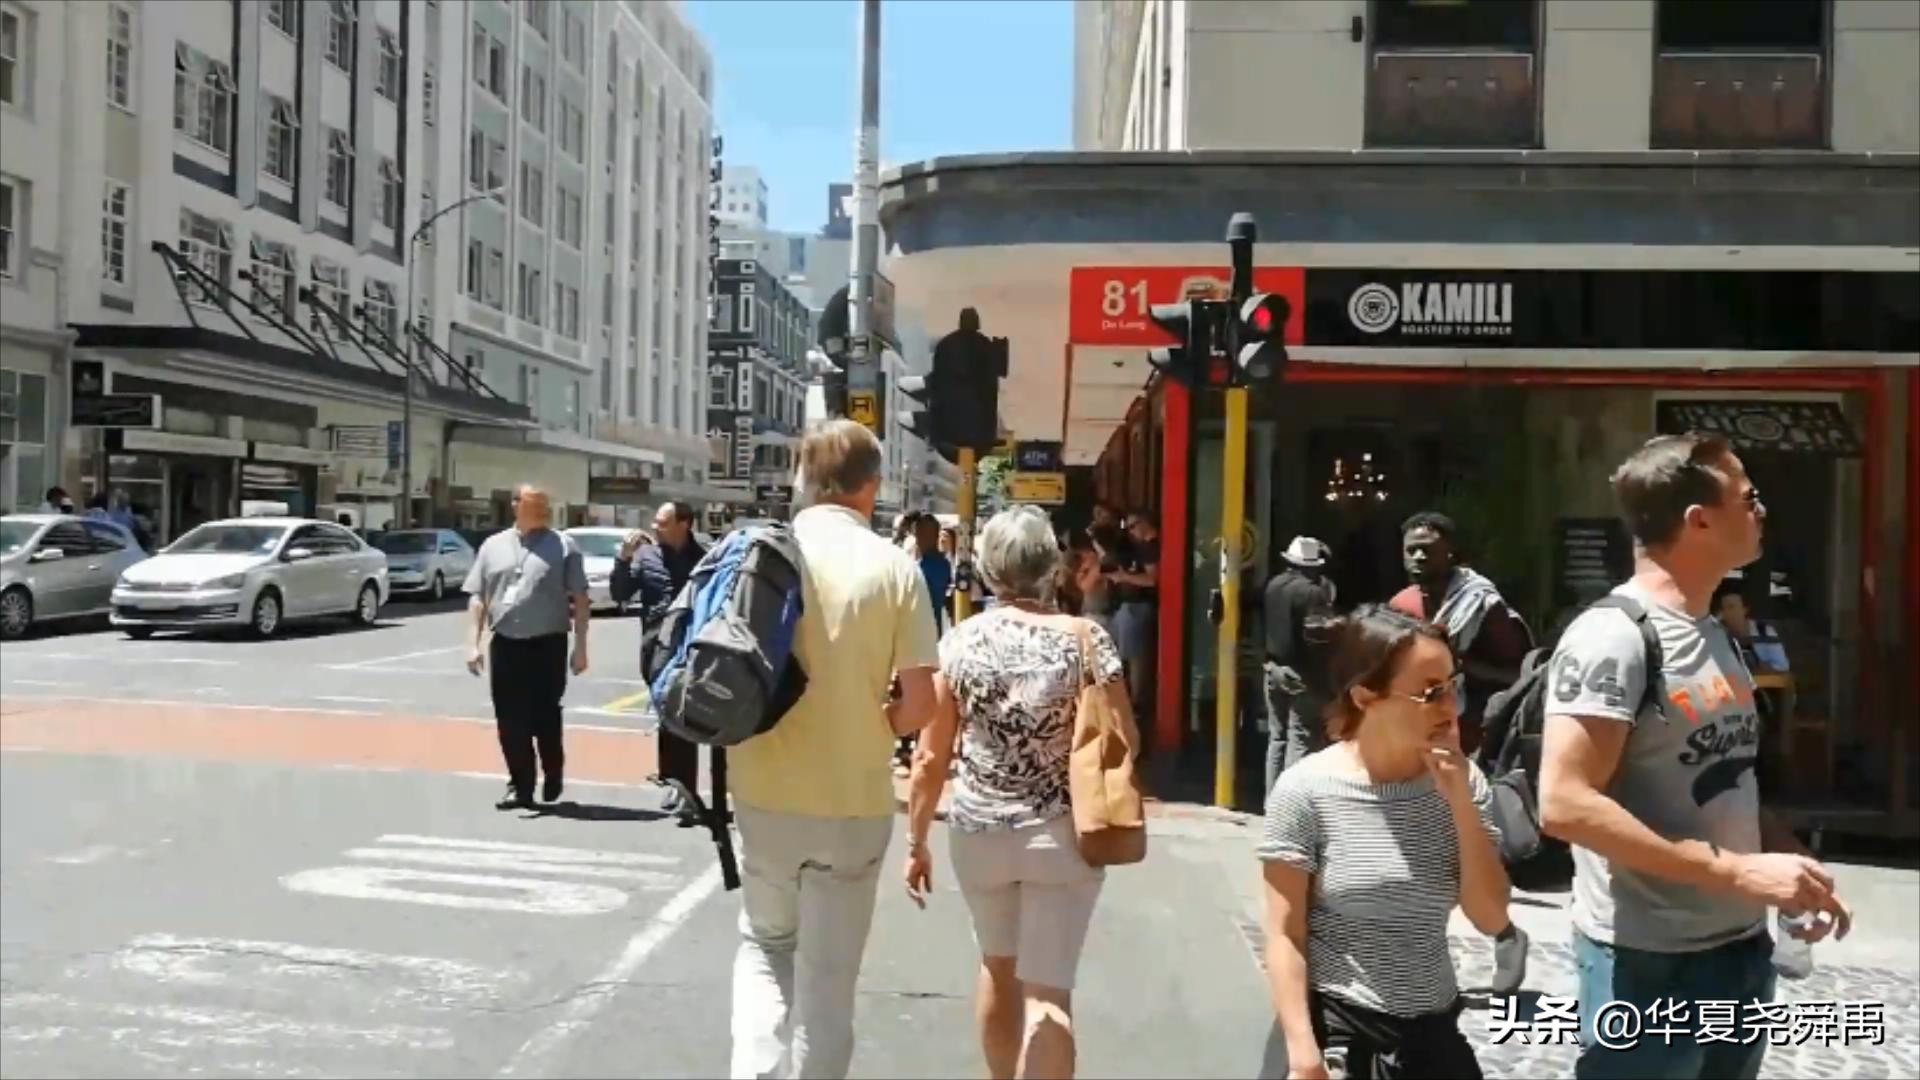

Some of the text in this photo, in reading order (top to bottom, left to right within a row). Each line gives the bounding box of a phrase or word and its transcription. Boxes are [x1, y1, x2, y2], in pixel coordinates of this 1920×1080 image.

[1102, 279, 1148, 317] 81
[1401, 282, 1513, 323] KAMILI
[1400, 324, 1513, 336] ROASTED TO ORDER
[1553, 654, 1626, 707] 64
